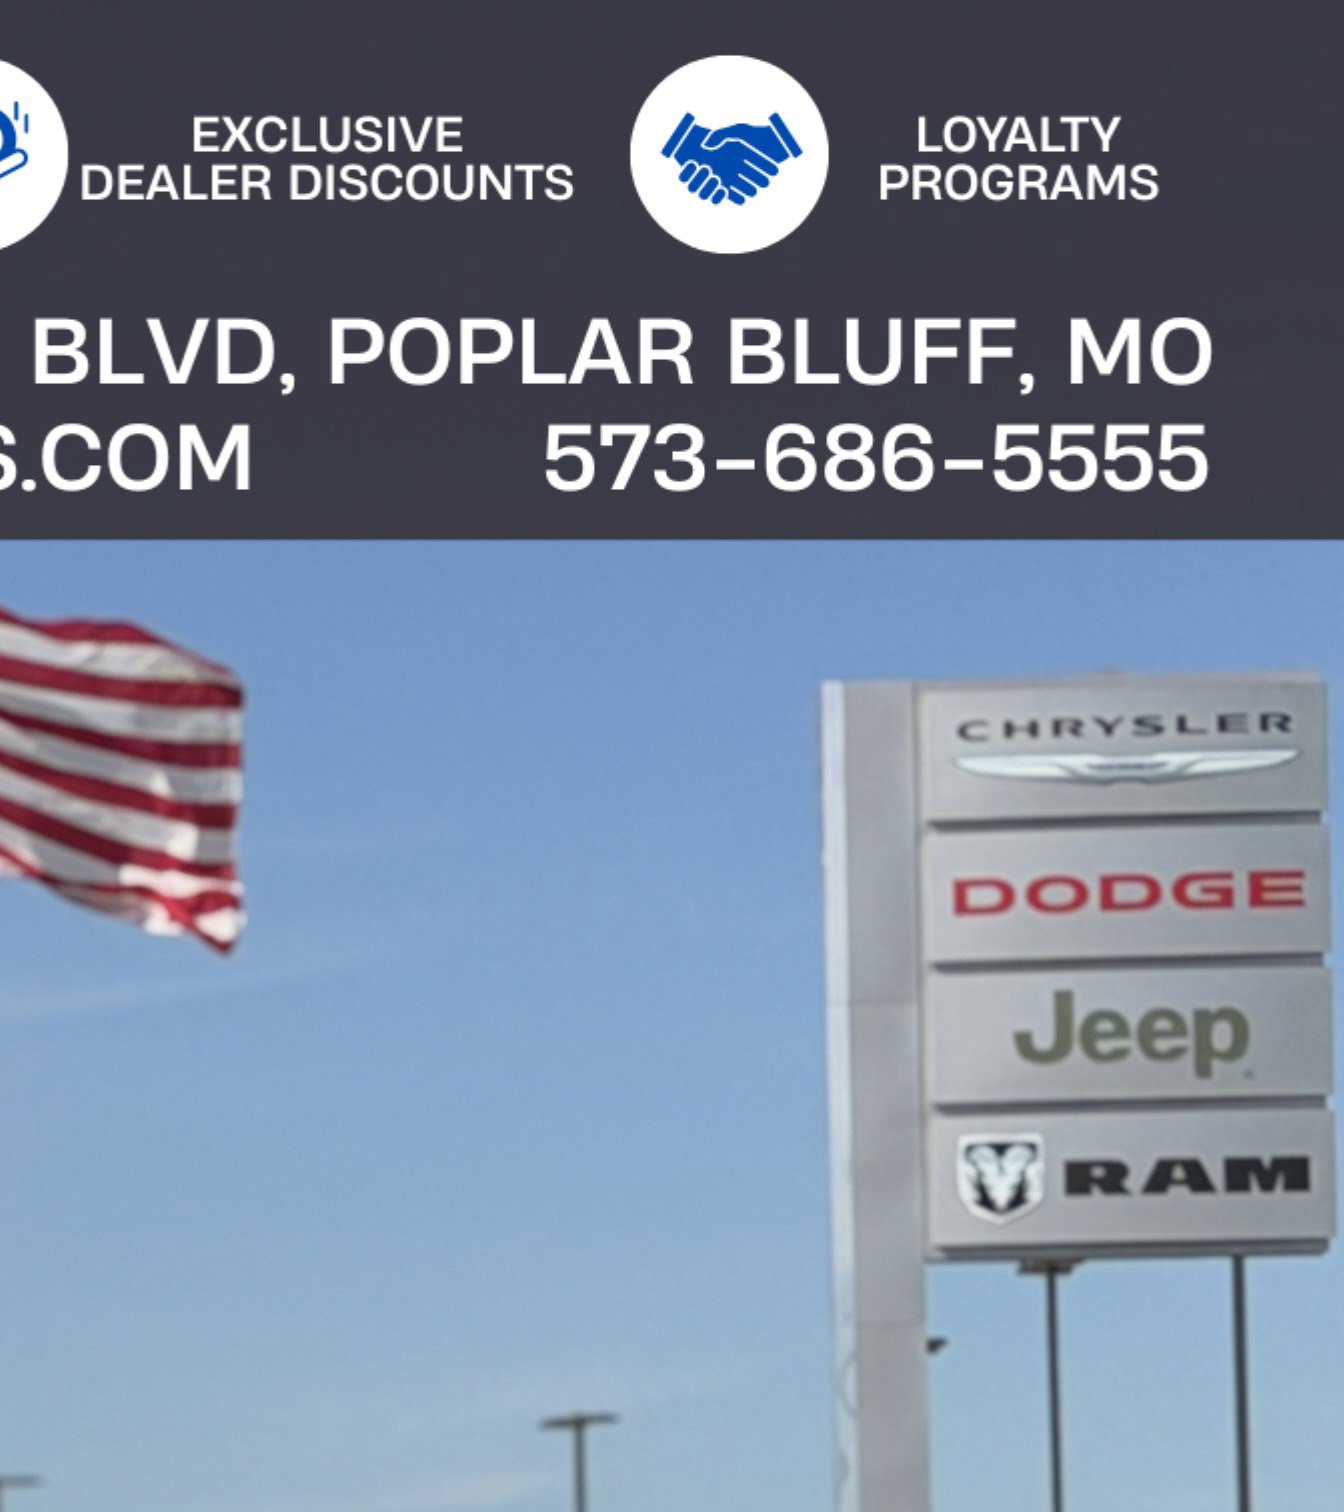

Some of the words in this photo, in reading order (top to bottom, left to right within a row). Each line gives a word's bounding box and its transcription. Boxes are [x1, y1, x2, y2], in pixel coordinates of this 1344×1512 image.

[956, 711, 1294, 743] CHRYSLER
[953, 869, 1307, 917] DODGE
[1014, 990, 1250, 1080] Jeep
[1064, 1155, 1311, 1196] RAM
